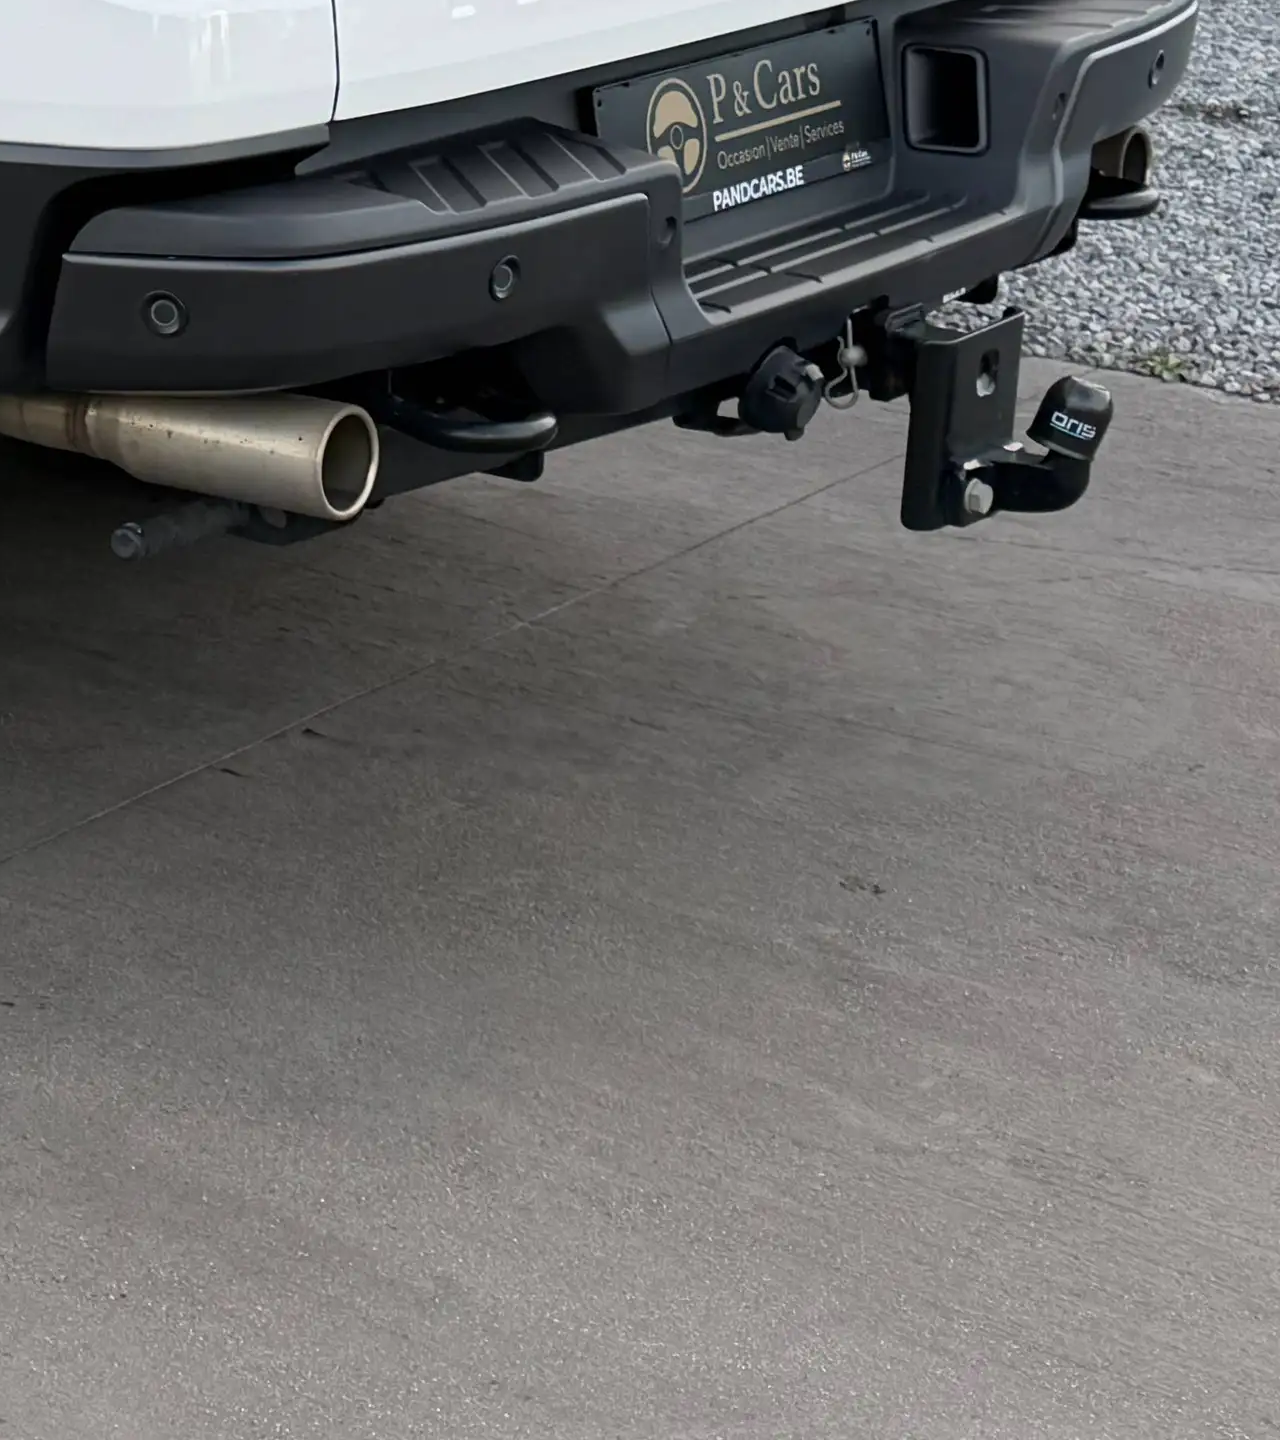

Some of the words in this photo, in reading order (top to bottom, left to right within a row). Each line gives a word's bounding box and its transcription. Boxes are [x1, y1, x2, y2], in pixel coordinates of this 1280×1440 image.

[717, 142, 766, 171] Occasion
[771, 132, 801, 155] Vente
[804, 119, 845, 145] Services
[713, 164, 806, 212] PANDCARS.BE
